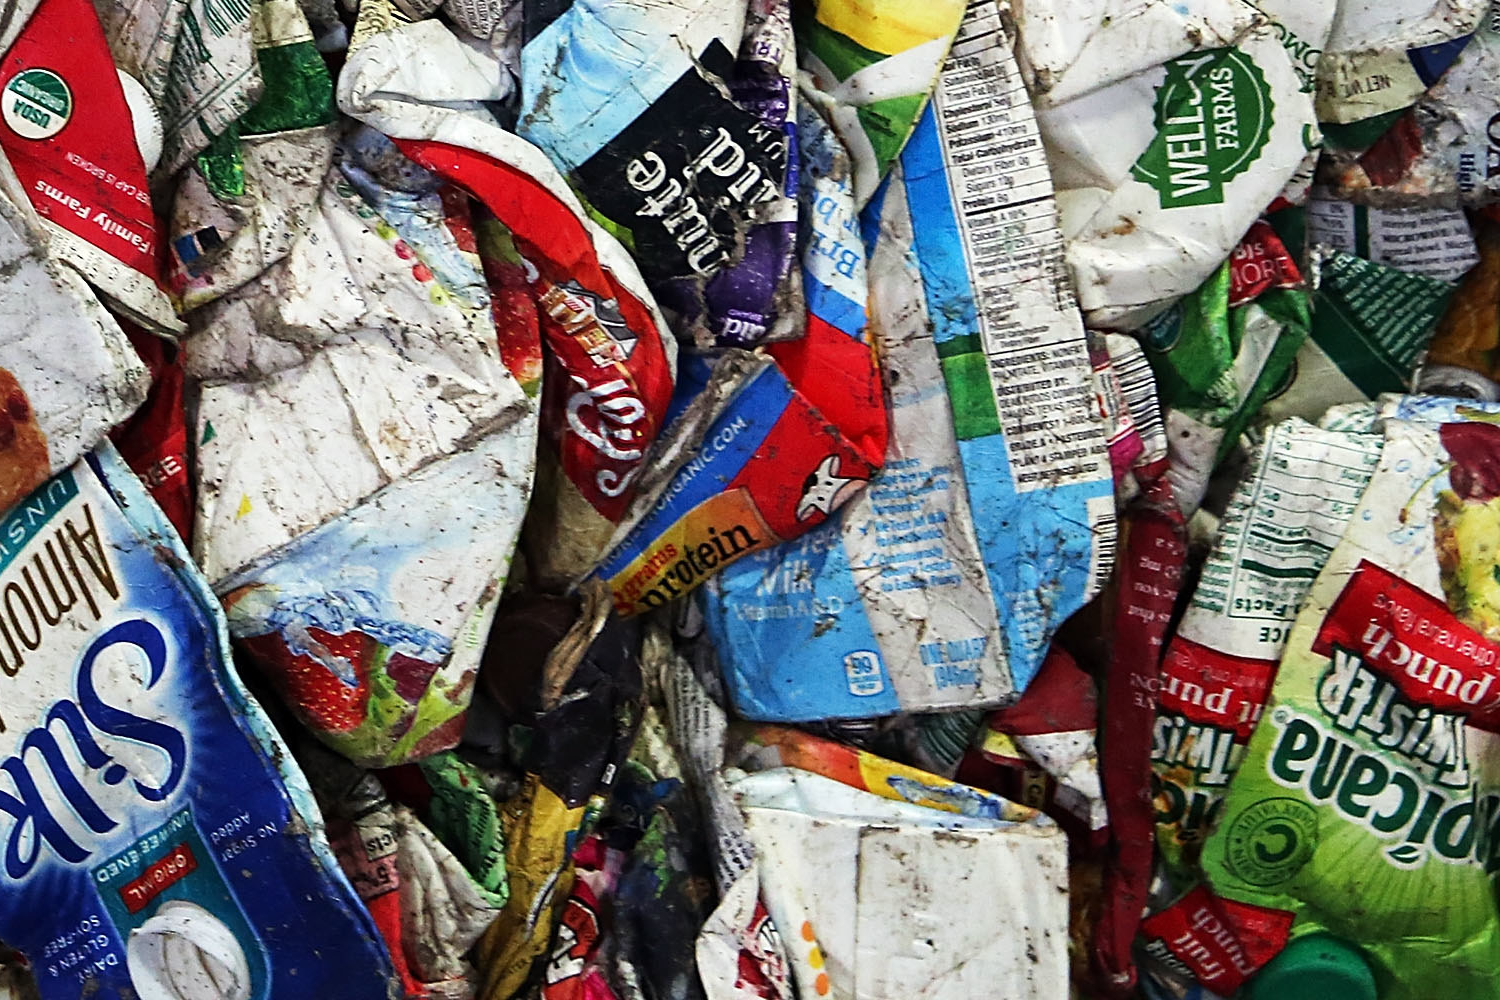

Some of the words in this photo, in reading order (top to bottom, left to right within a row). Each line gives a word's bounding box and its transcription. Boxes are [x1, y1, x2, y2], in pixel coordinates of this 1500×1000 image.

[10, 97, 53, 130] USDA
[1213, 64, 1240, 150] FARMS
[976, 136, 1038, 159] Carbohydrate
[32, 176, 93, 221] Farms
[91, 208, 153, 255] Family
[1234, 598, 1278, 618] Facts
[1361, 617, 1496, 708] punch
[209, 810, 251, 844] Added
[257, 818, 278, 840] No
[218, 832, 254, 864] Sugar
